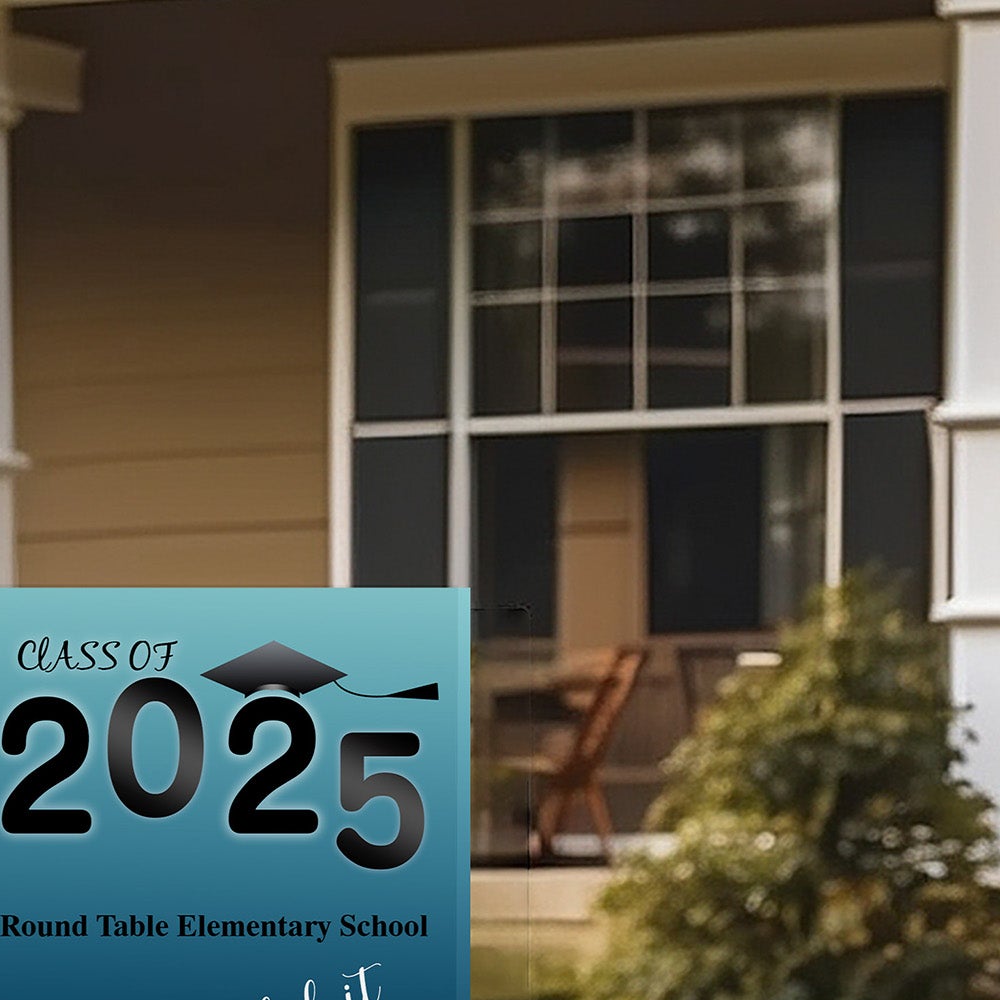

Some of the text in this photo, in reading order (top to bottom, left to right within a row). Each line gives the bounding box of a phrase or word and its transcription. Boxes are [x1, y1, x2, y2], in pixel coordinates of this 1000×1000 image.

[128, 640, 179, 672] OF
[1, 677, 426, 871] 2025
[0, 914, 429, 943] Round Table Elementary School
